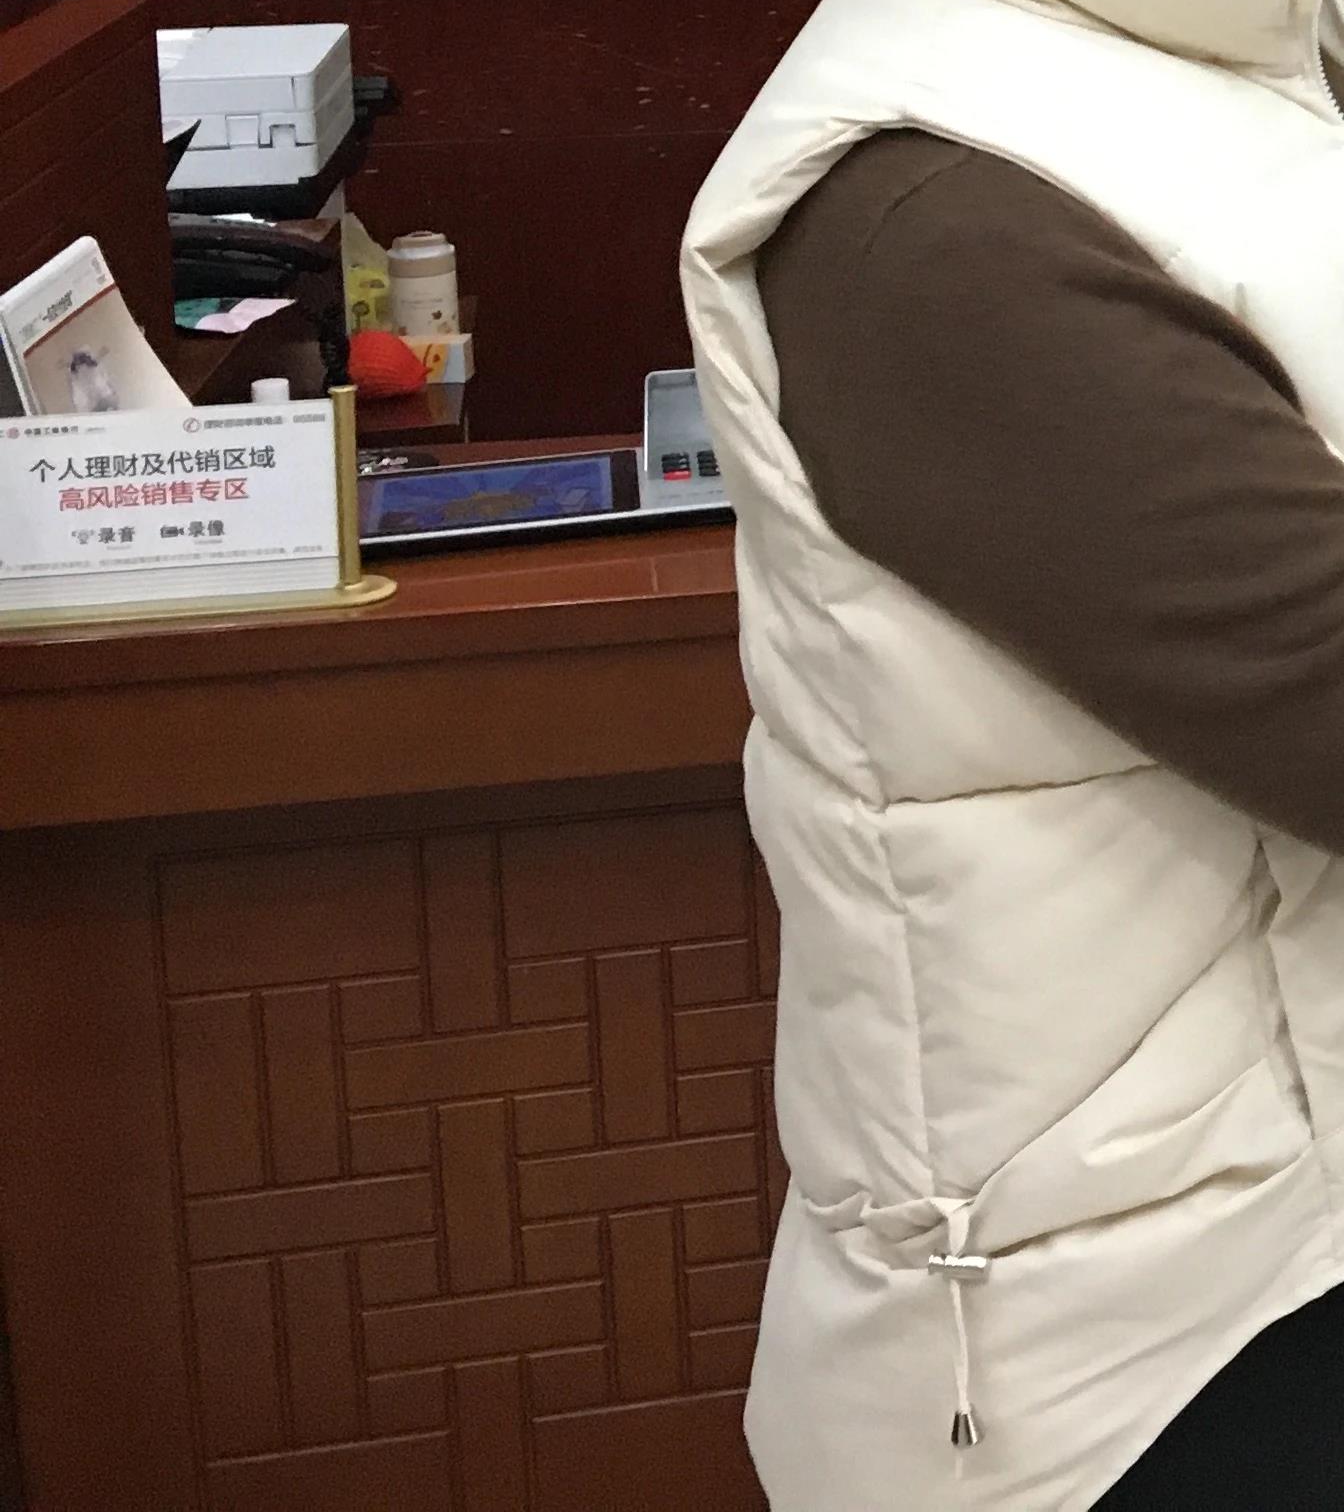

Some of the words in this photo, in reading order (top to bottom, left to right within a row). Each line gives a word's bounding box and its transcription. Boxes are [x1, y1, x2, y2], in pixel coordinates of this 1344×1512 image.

[29, 445, 276, 483] 个人理财及代销区域
[58, 477, 250, 512] 高风险销售专区
